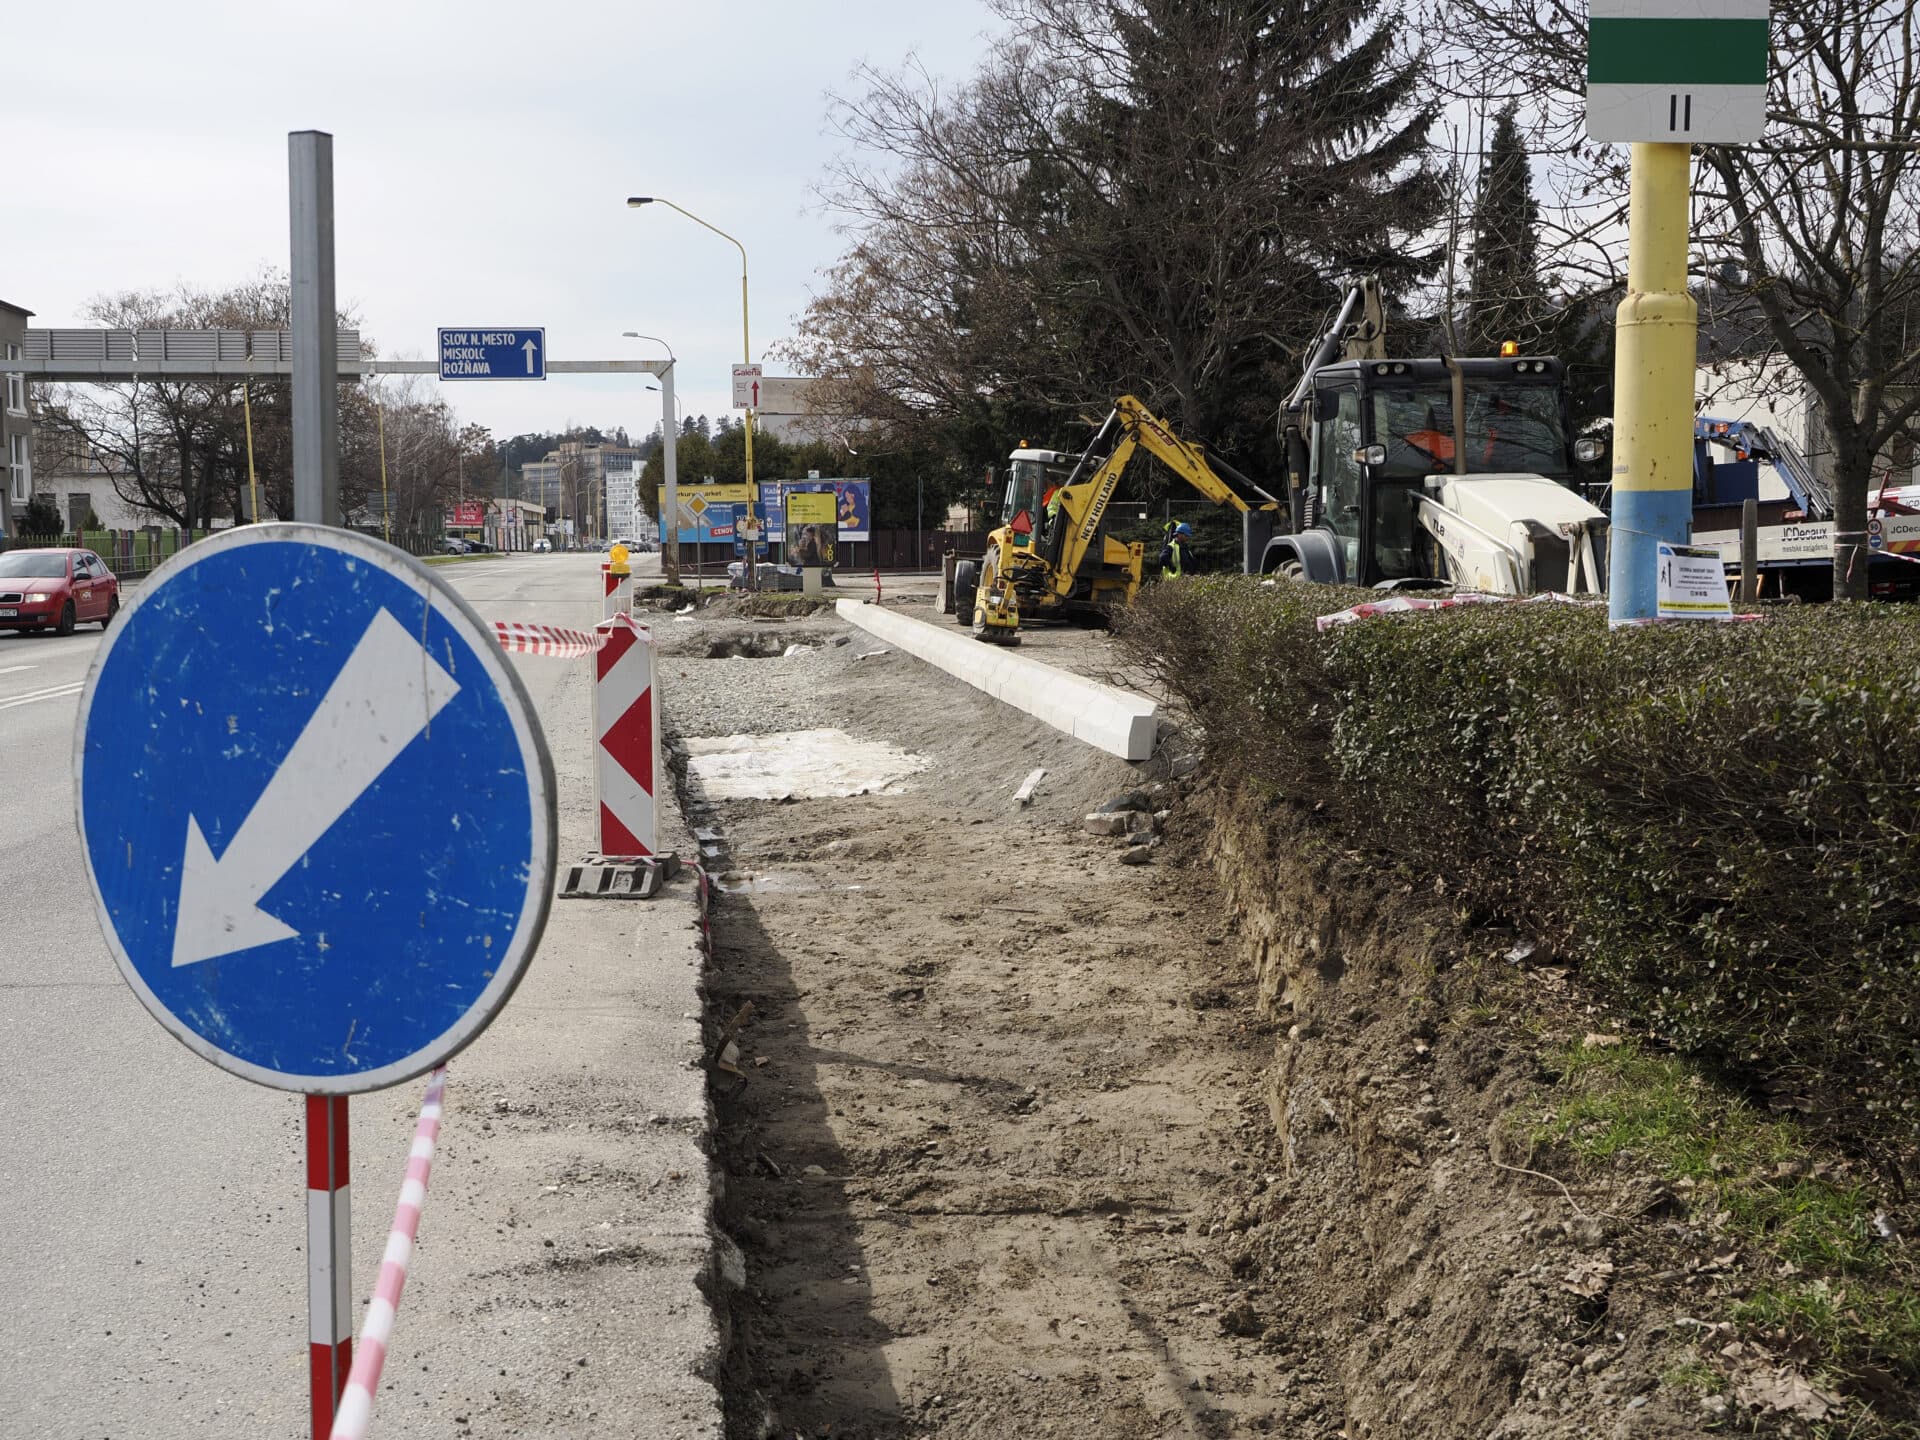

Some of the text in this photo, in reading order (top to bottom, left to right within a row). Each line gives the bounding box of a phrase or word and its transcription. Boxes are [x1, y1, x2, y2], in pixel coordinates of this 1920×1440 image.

[443, 333, 515, 345] SLOV. N. MESTO
[443, 347, 485, 360] MISKOLC
[443, 360, 491, 374] ROŽŇAVA
[1081, 472, 1117, 540] NEW HOLLAND
